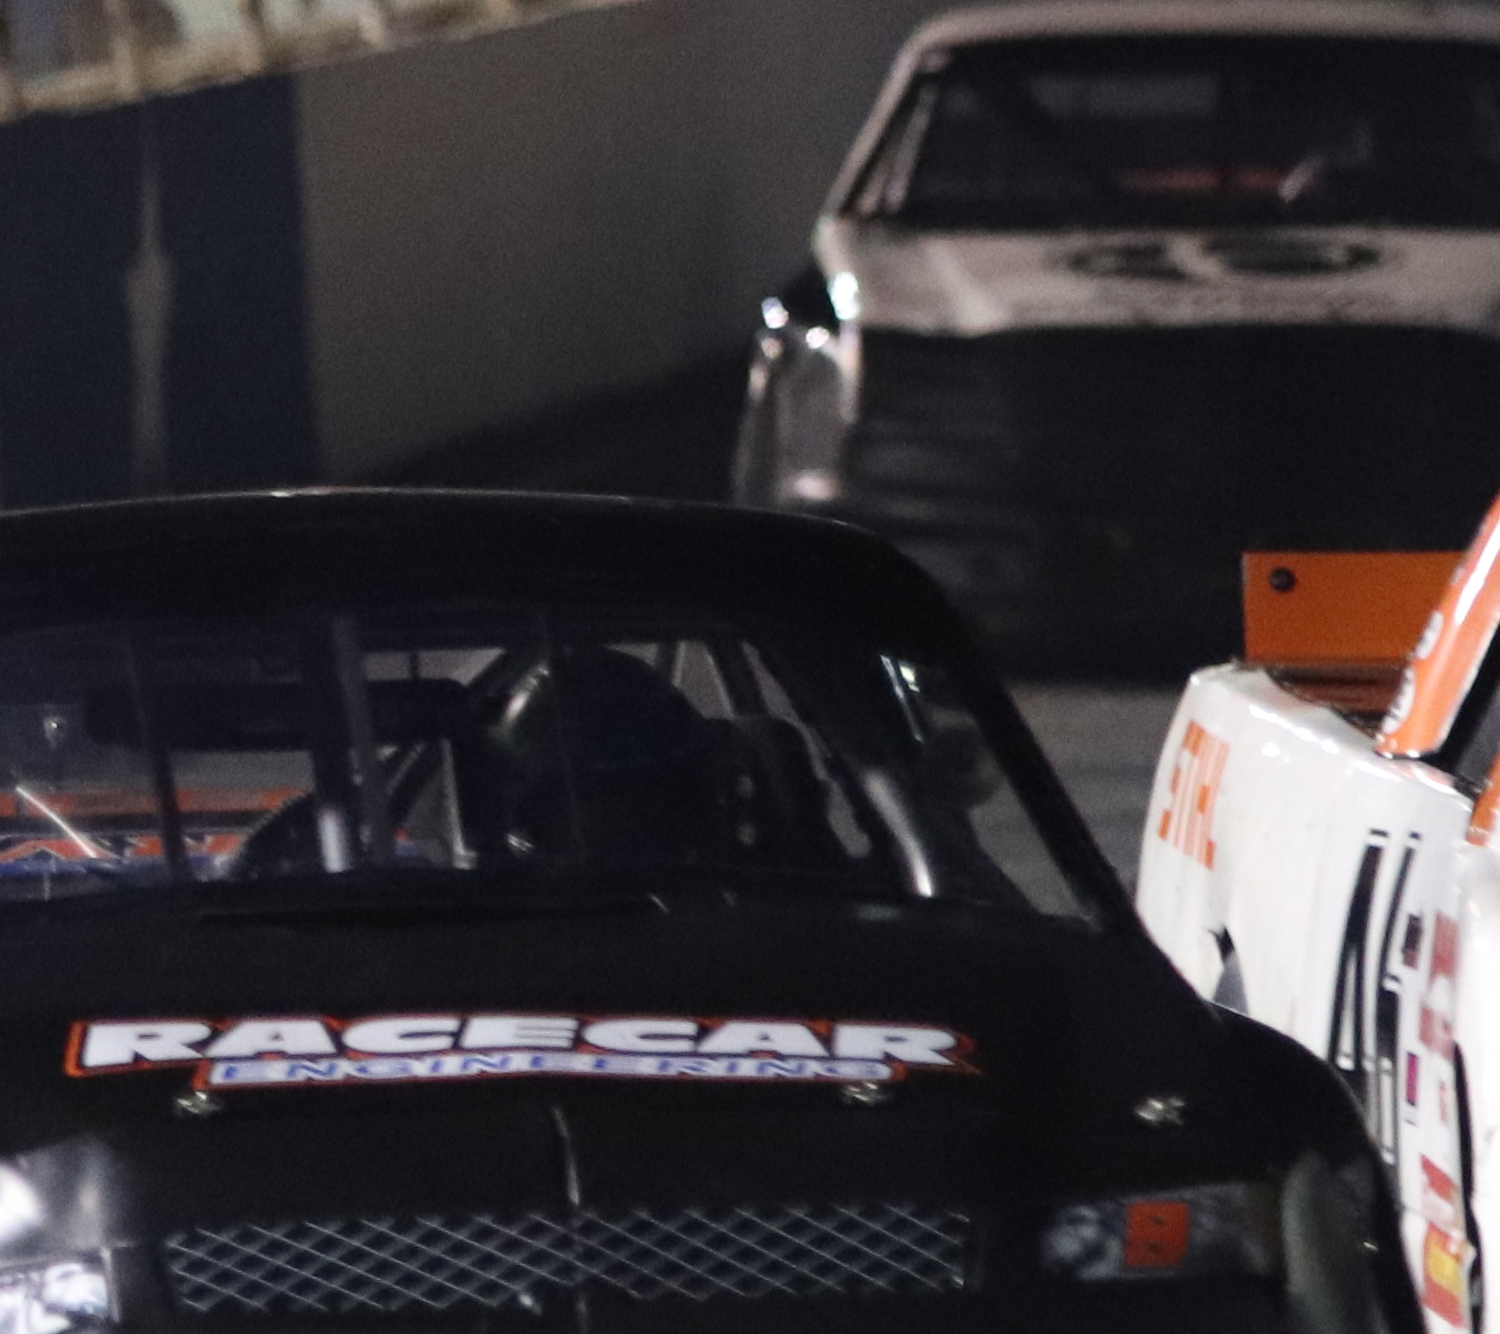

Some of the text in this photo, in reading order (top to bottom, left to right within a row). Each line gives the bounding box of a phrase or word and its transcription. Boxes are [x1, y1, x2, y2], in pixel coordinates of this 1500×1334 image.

[1158, 719, 1230, 870] STIHL
[83, 1014, 960, 1068] RACECAR
[216, 1050, 888, 1084] ENGINEERING
